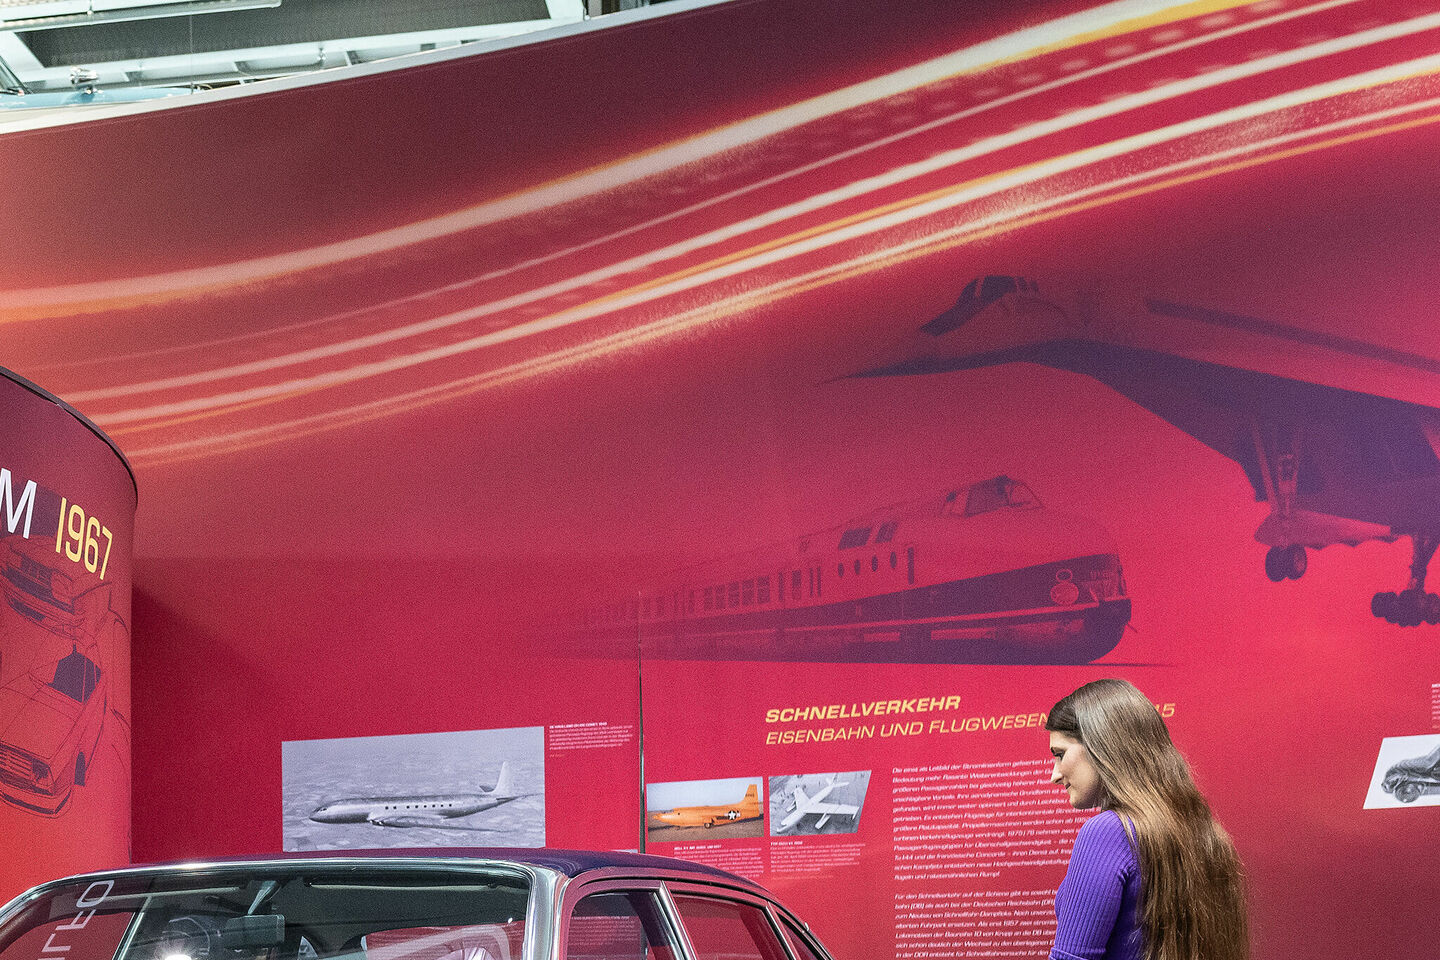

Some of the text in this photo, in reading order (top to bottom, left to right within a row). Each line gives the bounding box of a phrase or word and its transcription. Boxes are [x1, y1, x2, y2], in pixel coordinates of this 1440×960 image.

[54, 497, 113, 581] 1967
[765, 695, 962, 724] SCHNELLVERKEHR
[765, 711, 1049, 745] EISENBAHN UND FLUGWESEN
